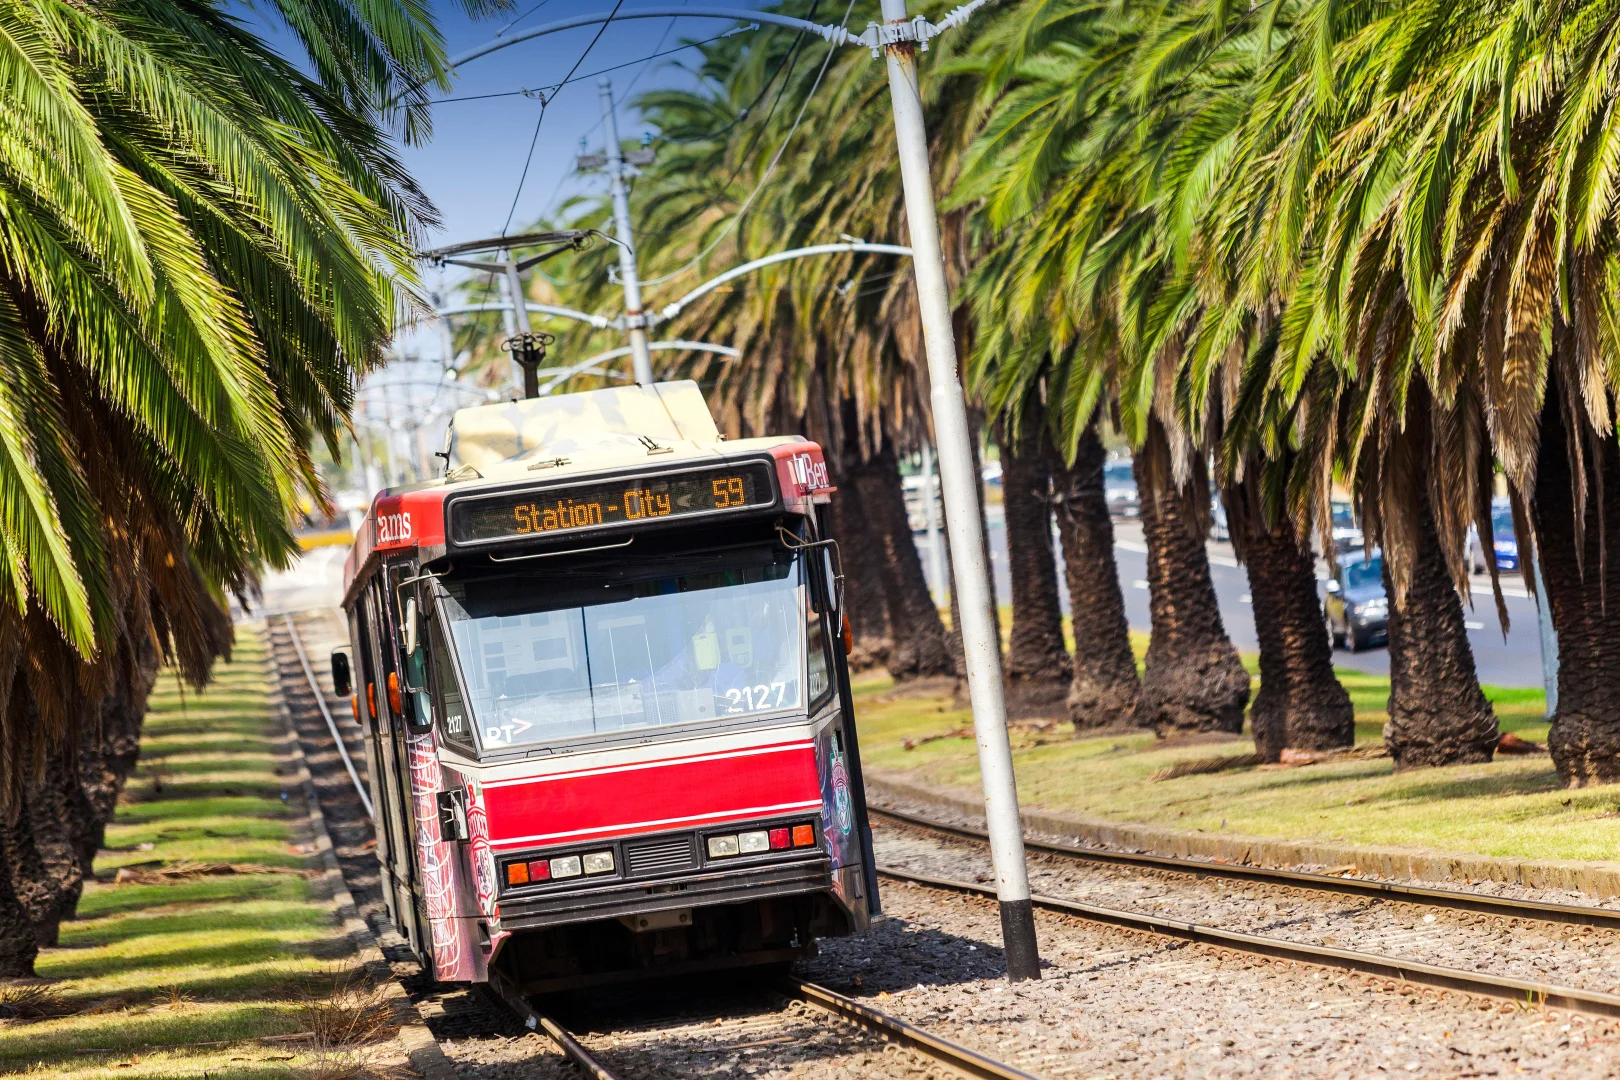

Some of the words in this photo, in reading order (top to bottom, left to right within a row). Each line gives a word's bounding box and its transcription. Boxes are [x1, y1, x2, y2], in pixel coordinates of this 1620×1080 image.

[514, 499, 603, 534] Station
[623, 490, 671, 520] City
[712, 477, 745, 508] 59
[377, 511, 412, 543] ams
[725, 682, 786, 713] 2127
[447, 715, 462, 734] 2127
